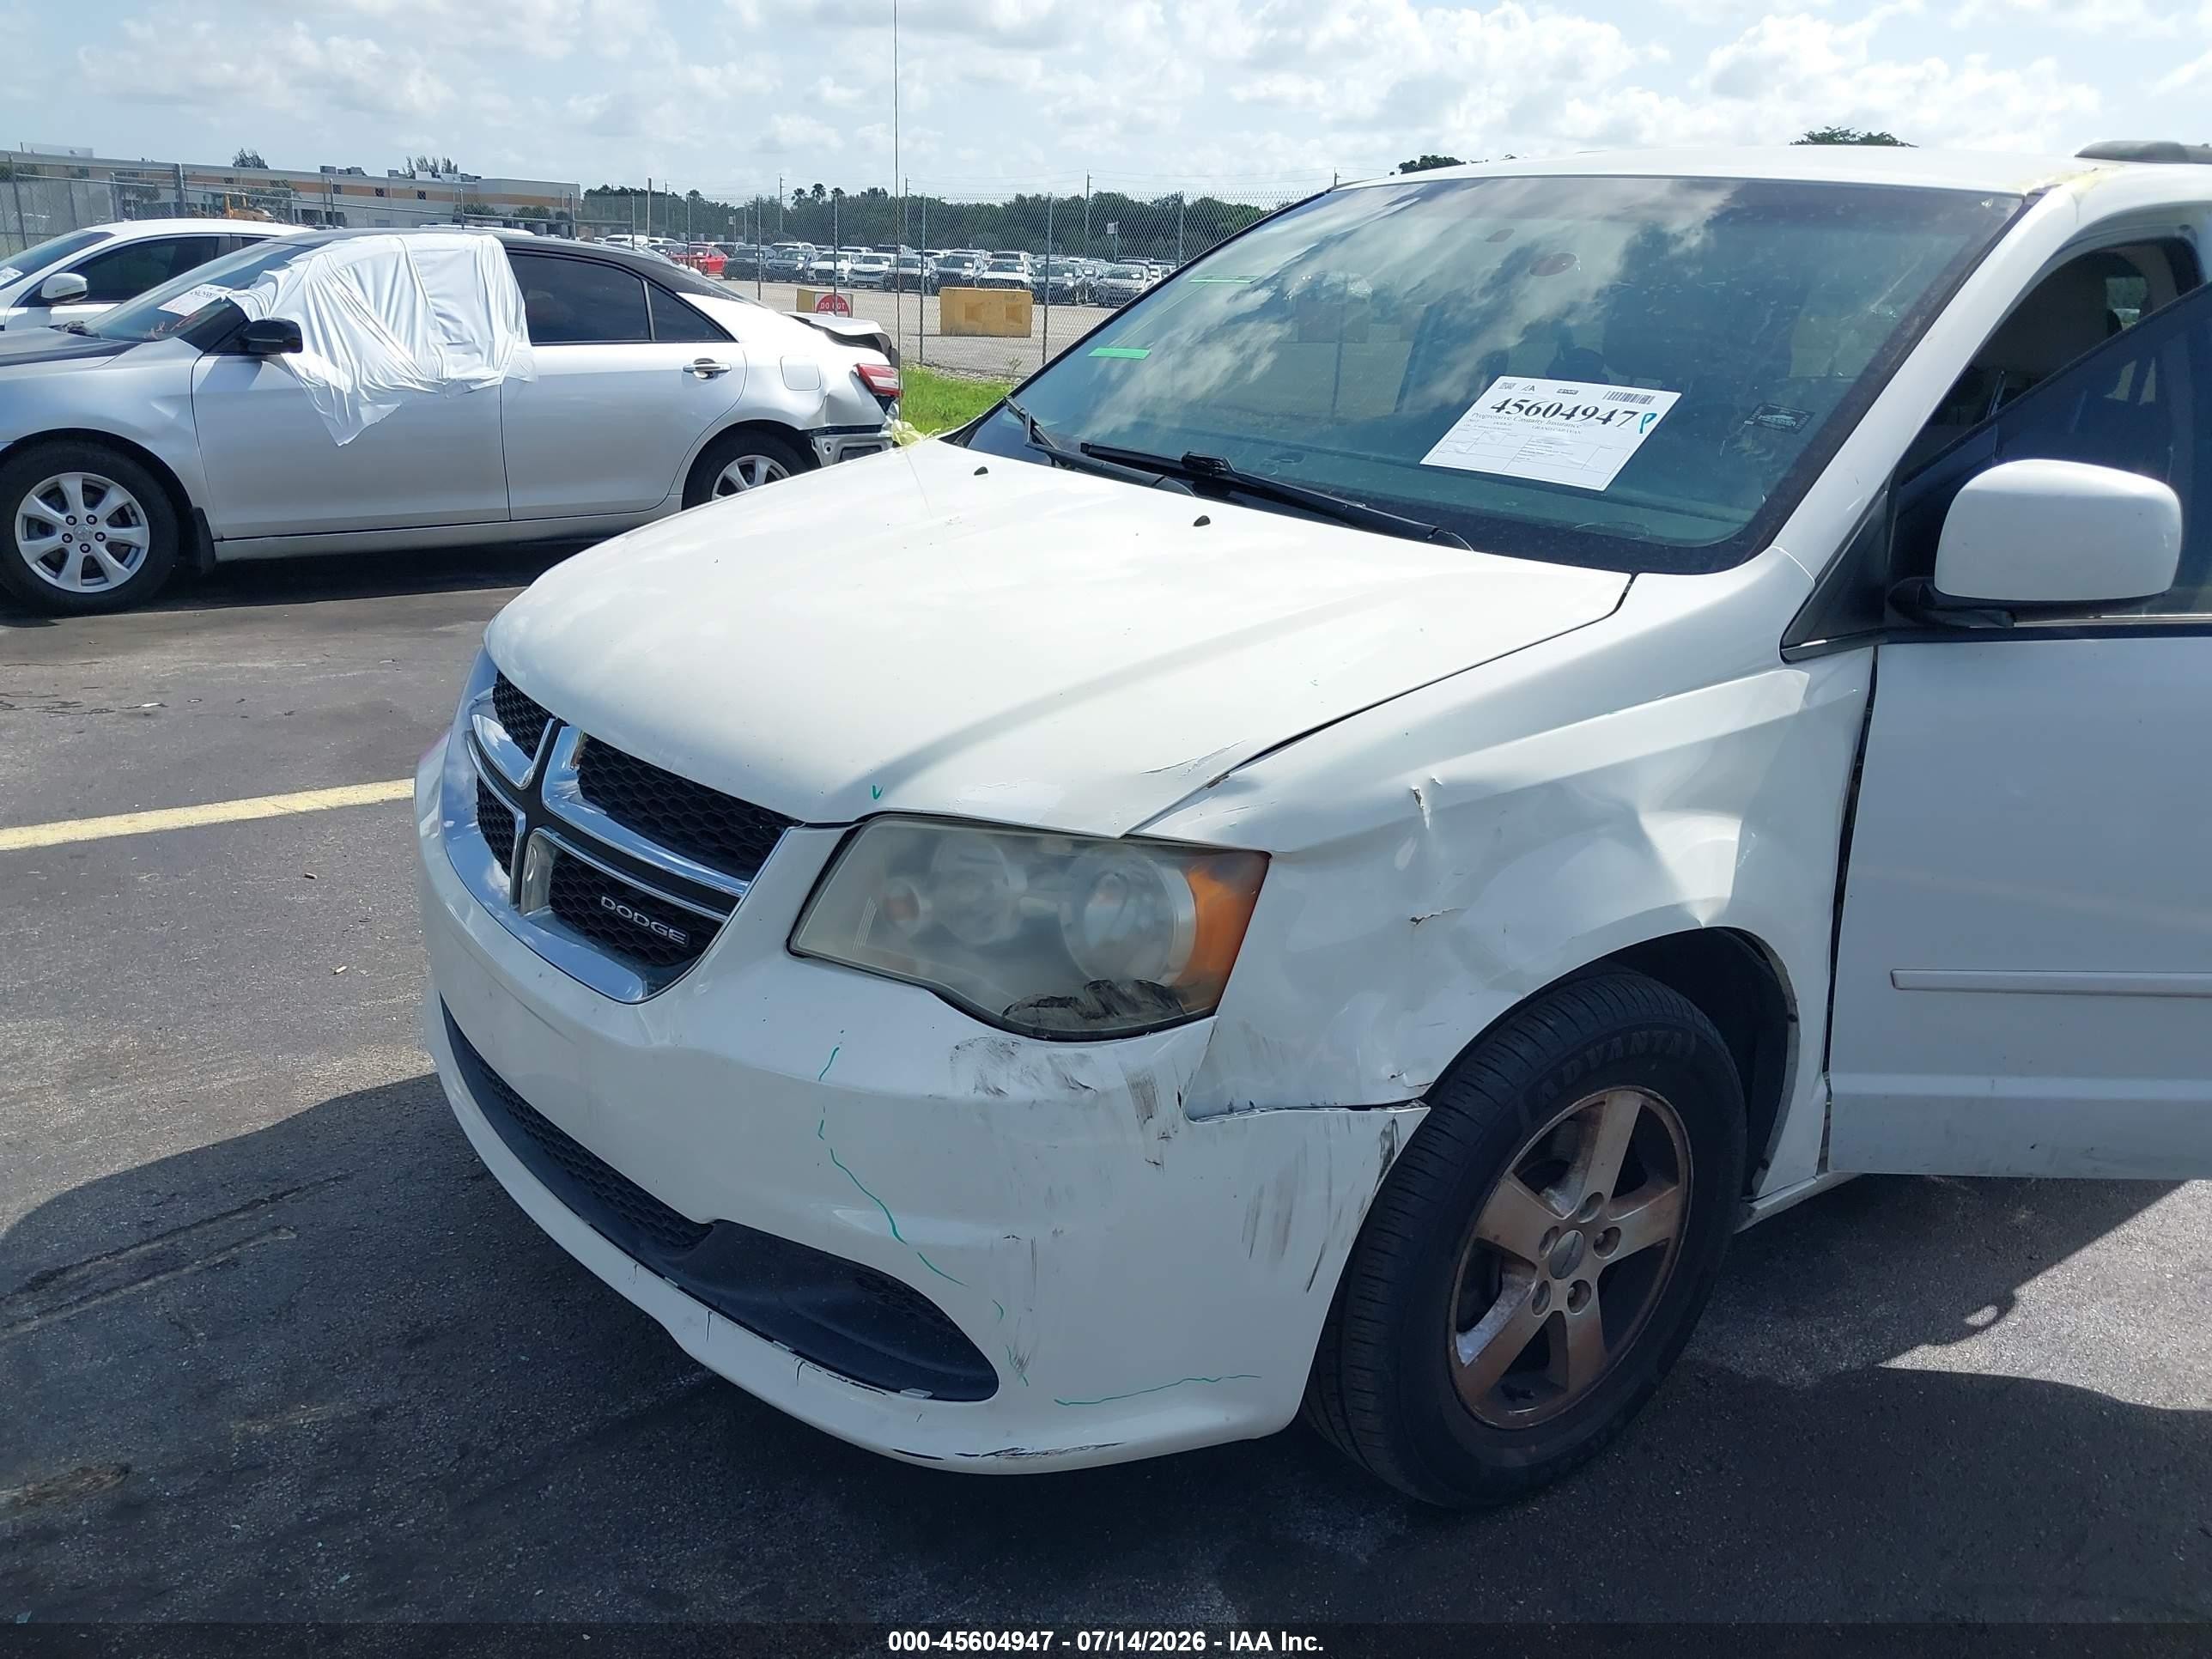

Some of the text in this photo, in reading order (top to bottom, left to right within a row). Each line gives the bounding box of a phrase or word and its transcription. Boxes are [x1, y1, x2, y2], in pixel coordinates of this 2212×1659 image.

[1490, 398, 1640, 428] 45604947
[1546, 418, 1583, 428] Insurance
[601, 896, 687, 945] DODGE
[1537, 1030, 1684, 1100] ADVANTA
